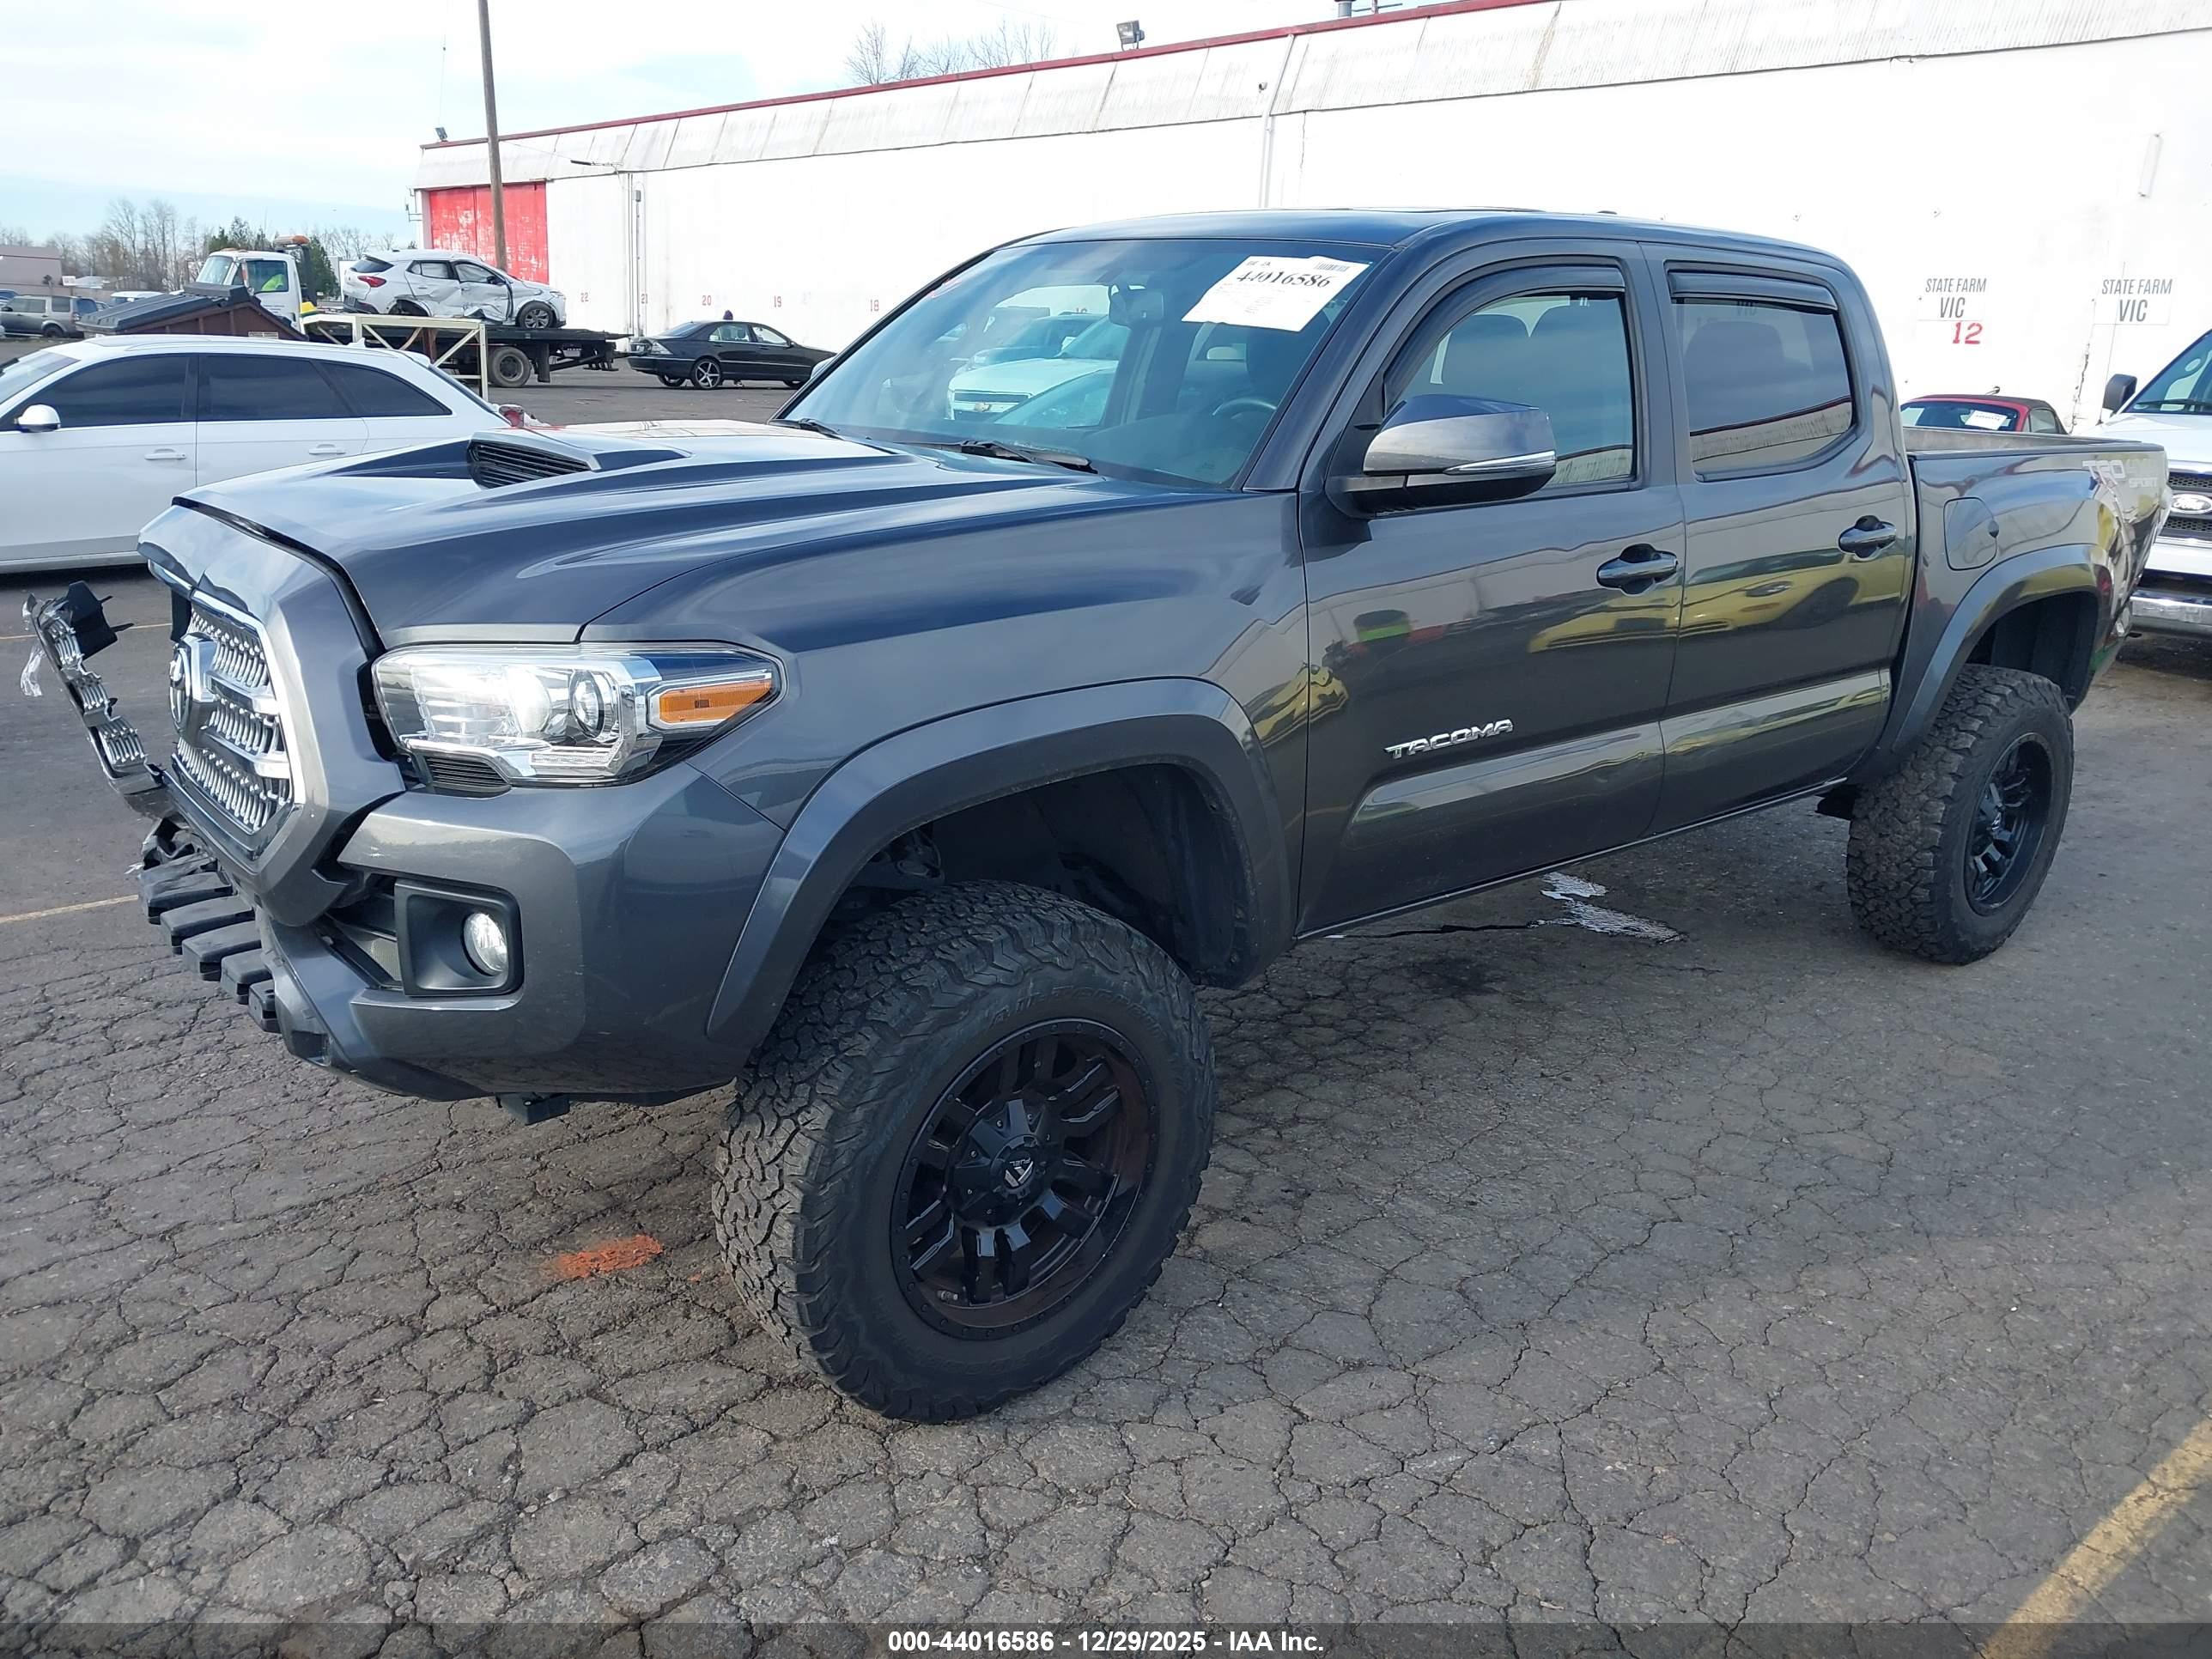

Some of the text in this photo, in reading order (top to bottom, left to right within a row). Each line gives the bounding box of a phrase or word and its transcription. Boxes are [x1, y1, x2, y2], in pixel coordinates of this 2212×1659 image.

[1925, 277, 1988, 294] STATE FARM
[2101, 278, 2173, 295] STATE FARM
[580, 292, 589, 302] 22
[702, 295, 712, 306] 20
[774, 295, 782, 308] 19
[869, 298, 879, 313] 18
[1939, 296, 1966, 319] VIC
[2118, 299, 2148, 322] VIC
[1952, 321, 1984, 345] 12
[2129, 477, 2159, 489] SPORT
[1384, 719, 1514, 759] TACOMA
